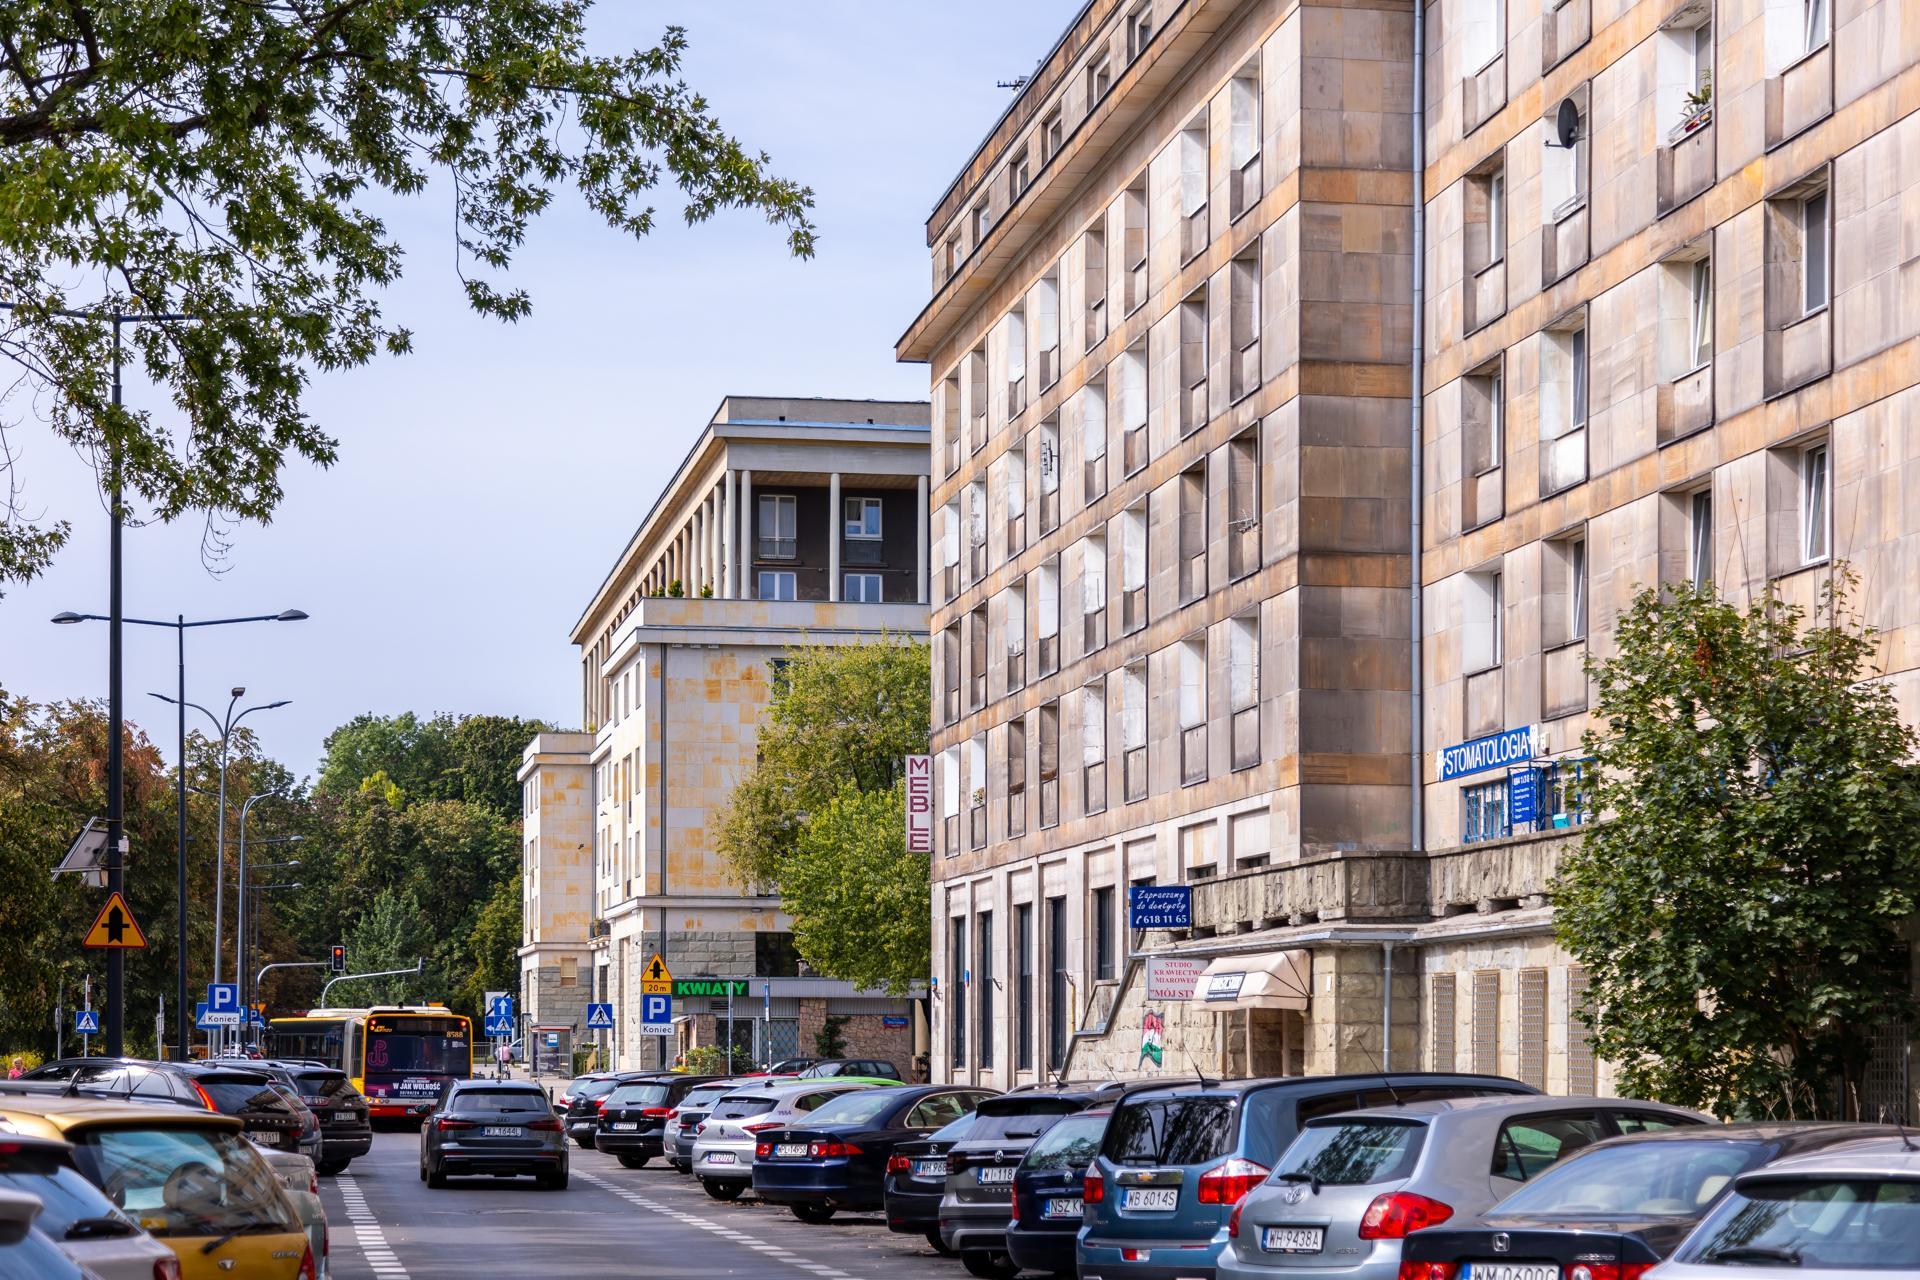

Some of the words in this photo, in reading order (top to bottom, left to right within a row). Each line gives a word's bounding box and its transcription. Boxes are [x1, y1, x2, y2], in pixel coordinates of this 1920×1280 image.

[1445, 731, 1529, 776] STOMATOLOGIA
[909, 757, 929, 851] MEBLE
[1137, 889, 1185, 903] Zapraszamy
[1136, 900, 1146, 910] do
[1148, 900, 1187, 913] dentysty
[1143, 915, 1161, 924] 618
[1162, 915, 1173, 924] 11
[1175, 914, 1187, 924] 65
[648, 984, 659, 992] 20
[677, 981, 746, 995] KWIATY
[214, 987, 232, 1010] P
[648, 997, 666, 1020] P
[208, 1015, 237, 1023] Koniec
[643, 1025, 672, 1034] Koniec
[1128, 1191, 1141, 1206] WB
[1143, 1191, 1175, 1206] 6014S
[1050, 1199, 1070, 1213] NSZ
[1269, 1230, 1283, 1247] WH
[1286, 1230, 1319, 1248] 9438A
